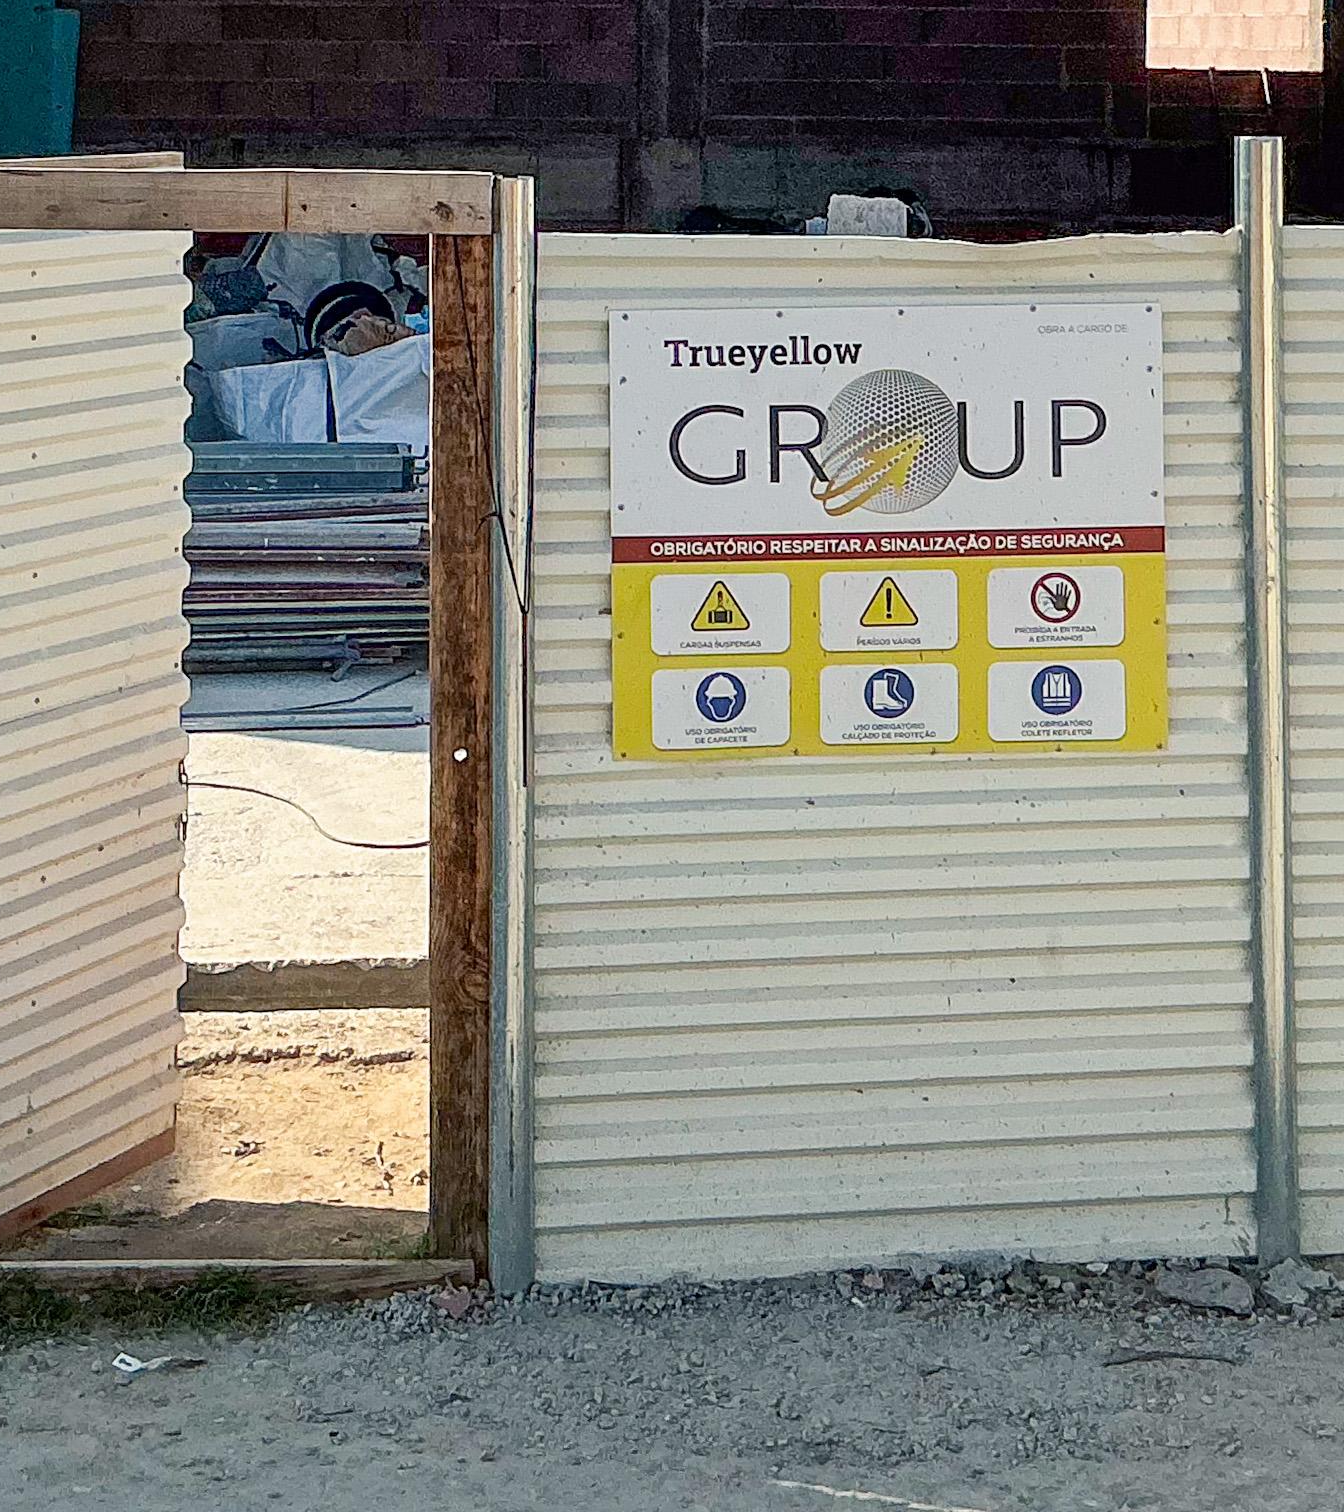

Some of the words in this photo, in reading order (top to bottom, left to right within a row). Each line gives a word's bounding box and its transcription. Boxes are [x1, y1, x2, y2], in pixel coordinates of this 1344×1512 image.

[1038, 325, 1065, 334] OBRA
[1068, 325, 1075, 333] A
[1077, 323, 1113, 334] CARGO
[1115, 324, 1128, 333] DE
[664, 336, 862, 373] Trueyellow
[650, 538, 767, 556] OBRIGATÓRIO
[770, 539, 862, 554] RESPEITAR
[864, 539, 878, 552] A
[881, 534, 992, 554] SINALIZAÇÃO
[995, 536, 1017, 549] DE
[1020, 533, 1124, 551] SEGURANÇA
